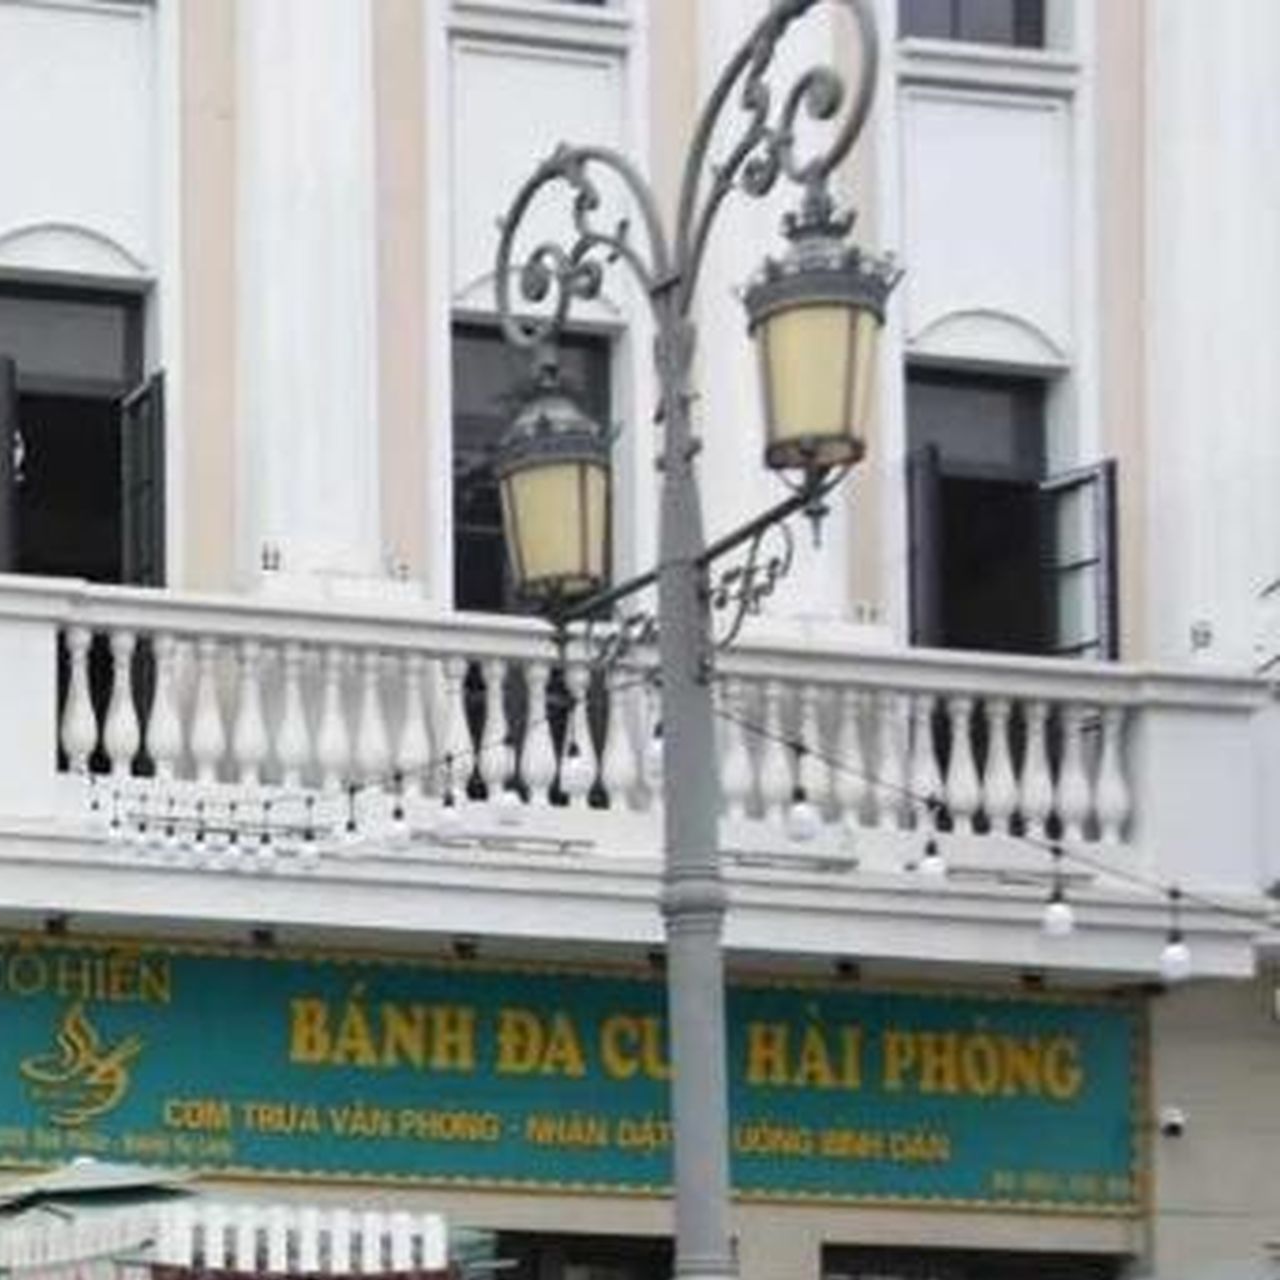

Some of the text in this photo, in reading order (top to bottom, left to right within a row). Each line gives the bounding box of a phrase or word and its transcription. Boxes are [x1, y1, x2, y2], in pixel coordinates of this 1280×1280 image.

[290, 981, 1082, 1098] BÁNH ĐA CU HẢI PHÒNG
